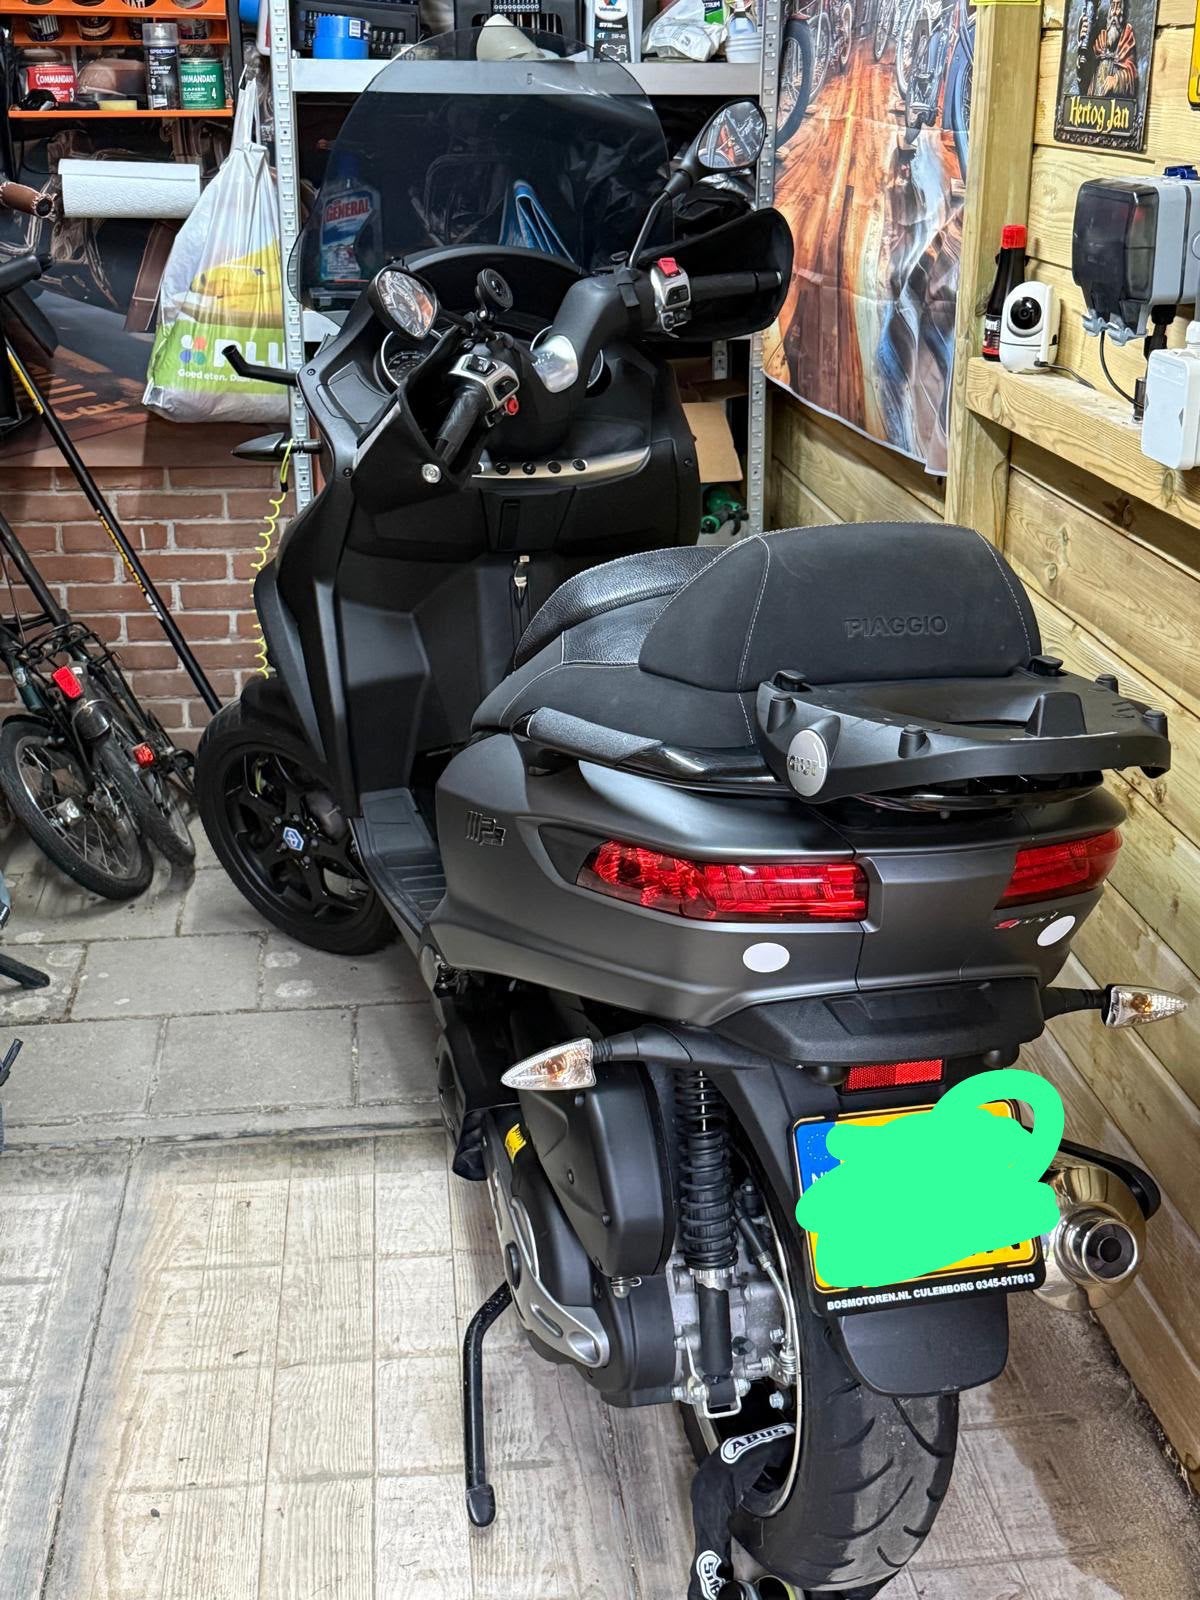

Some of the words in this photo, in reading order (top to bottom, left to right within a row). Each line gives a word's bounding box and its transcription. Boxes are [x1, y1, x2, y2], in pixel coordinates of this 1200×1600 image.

[36, 73, 74, 86] COMMANDANT
[211, 87, 217, 100] 4
[1069, 96, 1106, 133] Hertog
[1106, 98, 1130, 132] Jan
[327, 198, 369, 221] GENERAL
[213, 339, 287, 370] PLU
[178, 369, 203, 380] Goed
[203, 372, 228, 382] eten.
[843, 615, 948, 638] PIAGGIO
[827, 1291, 912, 1311] BOSMOTOREN.NL
[913, 1283, 974, 1298] CULEMBORG
[976, 1273, 1035, 1290] 0345-517613
[731, 1427, 787, 1455] ABUS
